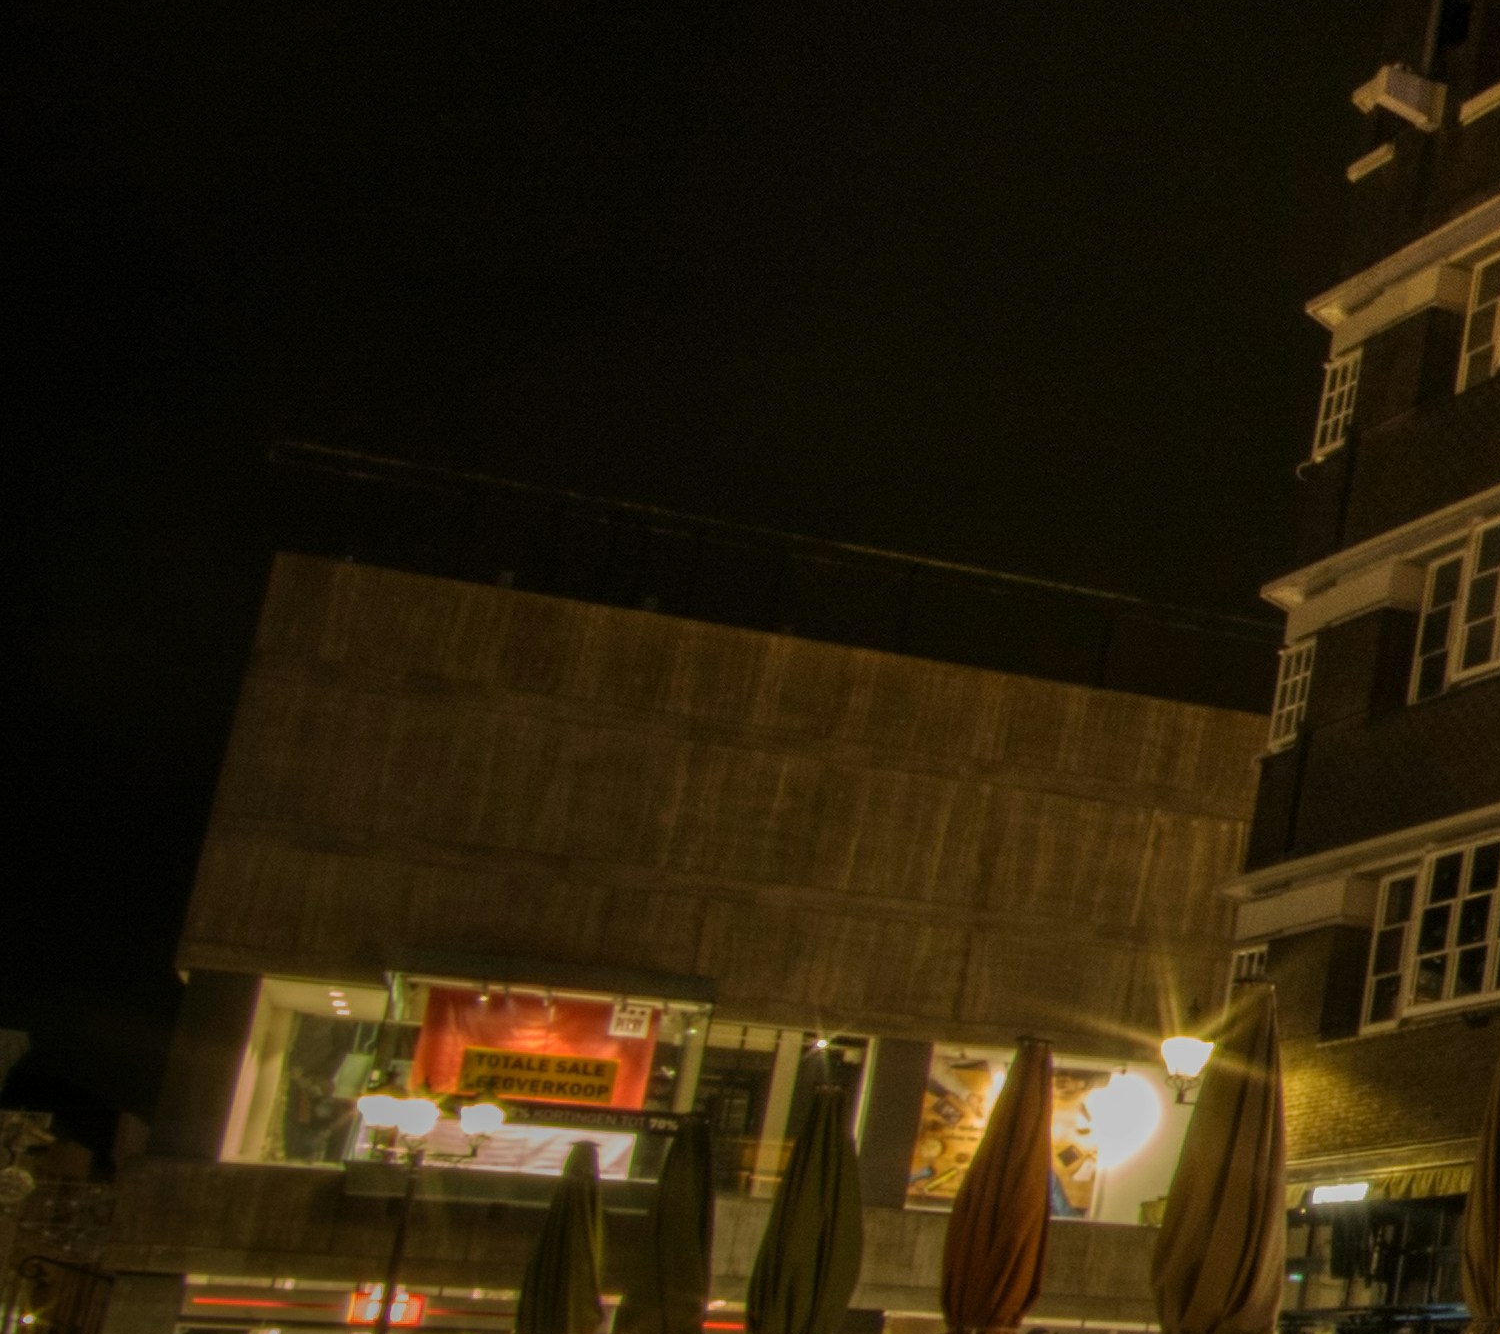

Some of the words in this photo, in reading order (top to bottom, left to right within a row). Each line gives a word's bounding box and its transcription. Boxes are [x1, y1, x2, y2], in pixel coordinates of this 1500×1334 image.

[477, 1052, 549, 1073] TOTALE
[555, 1060, 607, 1078] SALE
[534, 1109, 617, 1127] KORTINGEN
[621, 1114, 645, 1129] TOT
